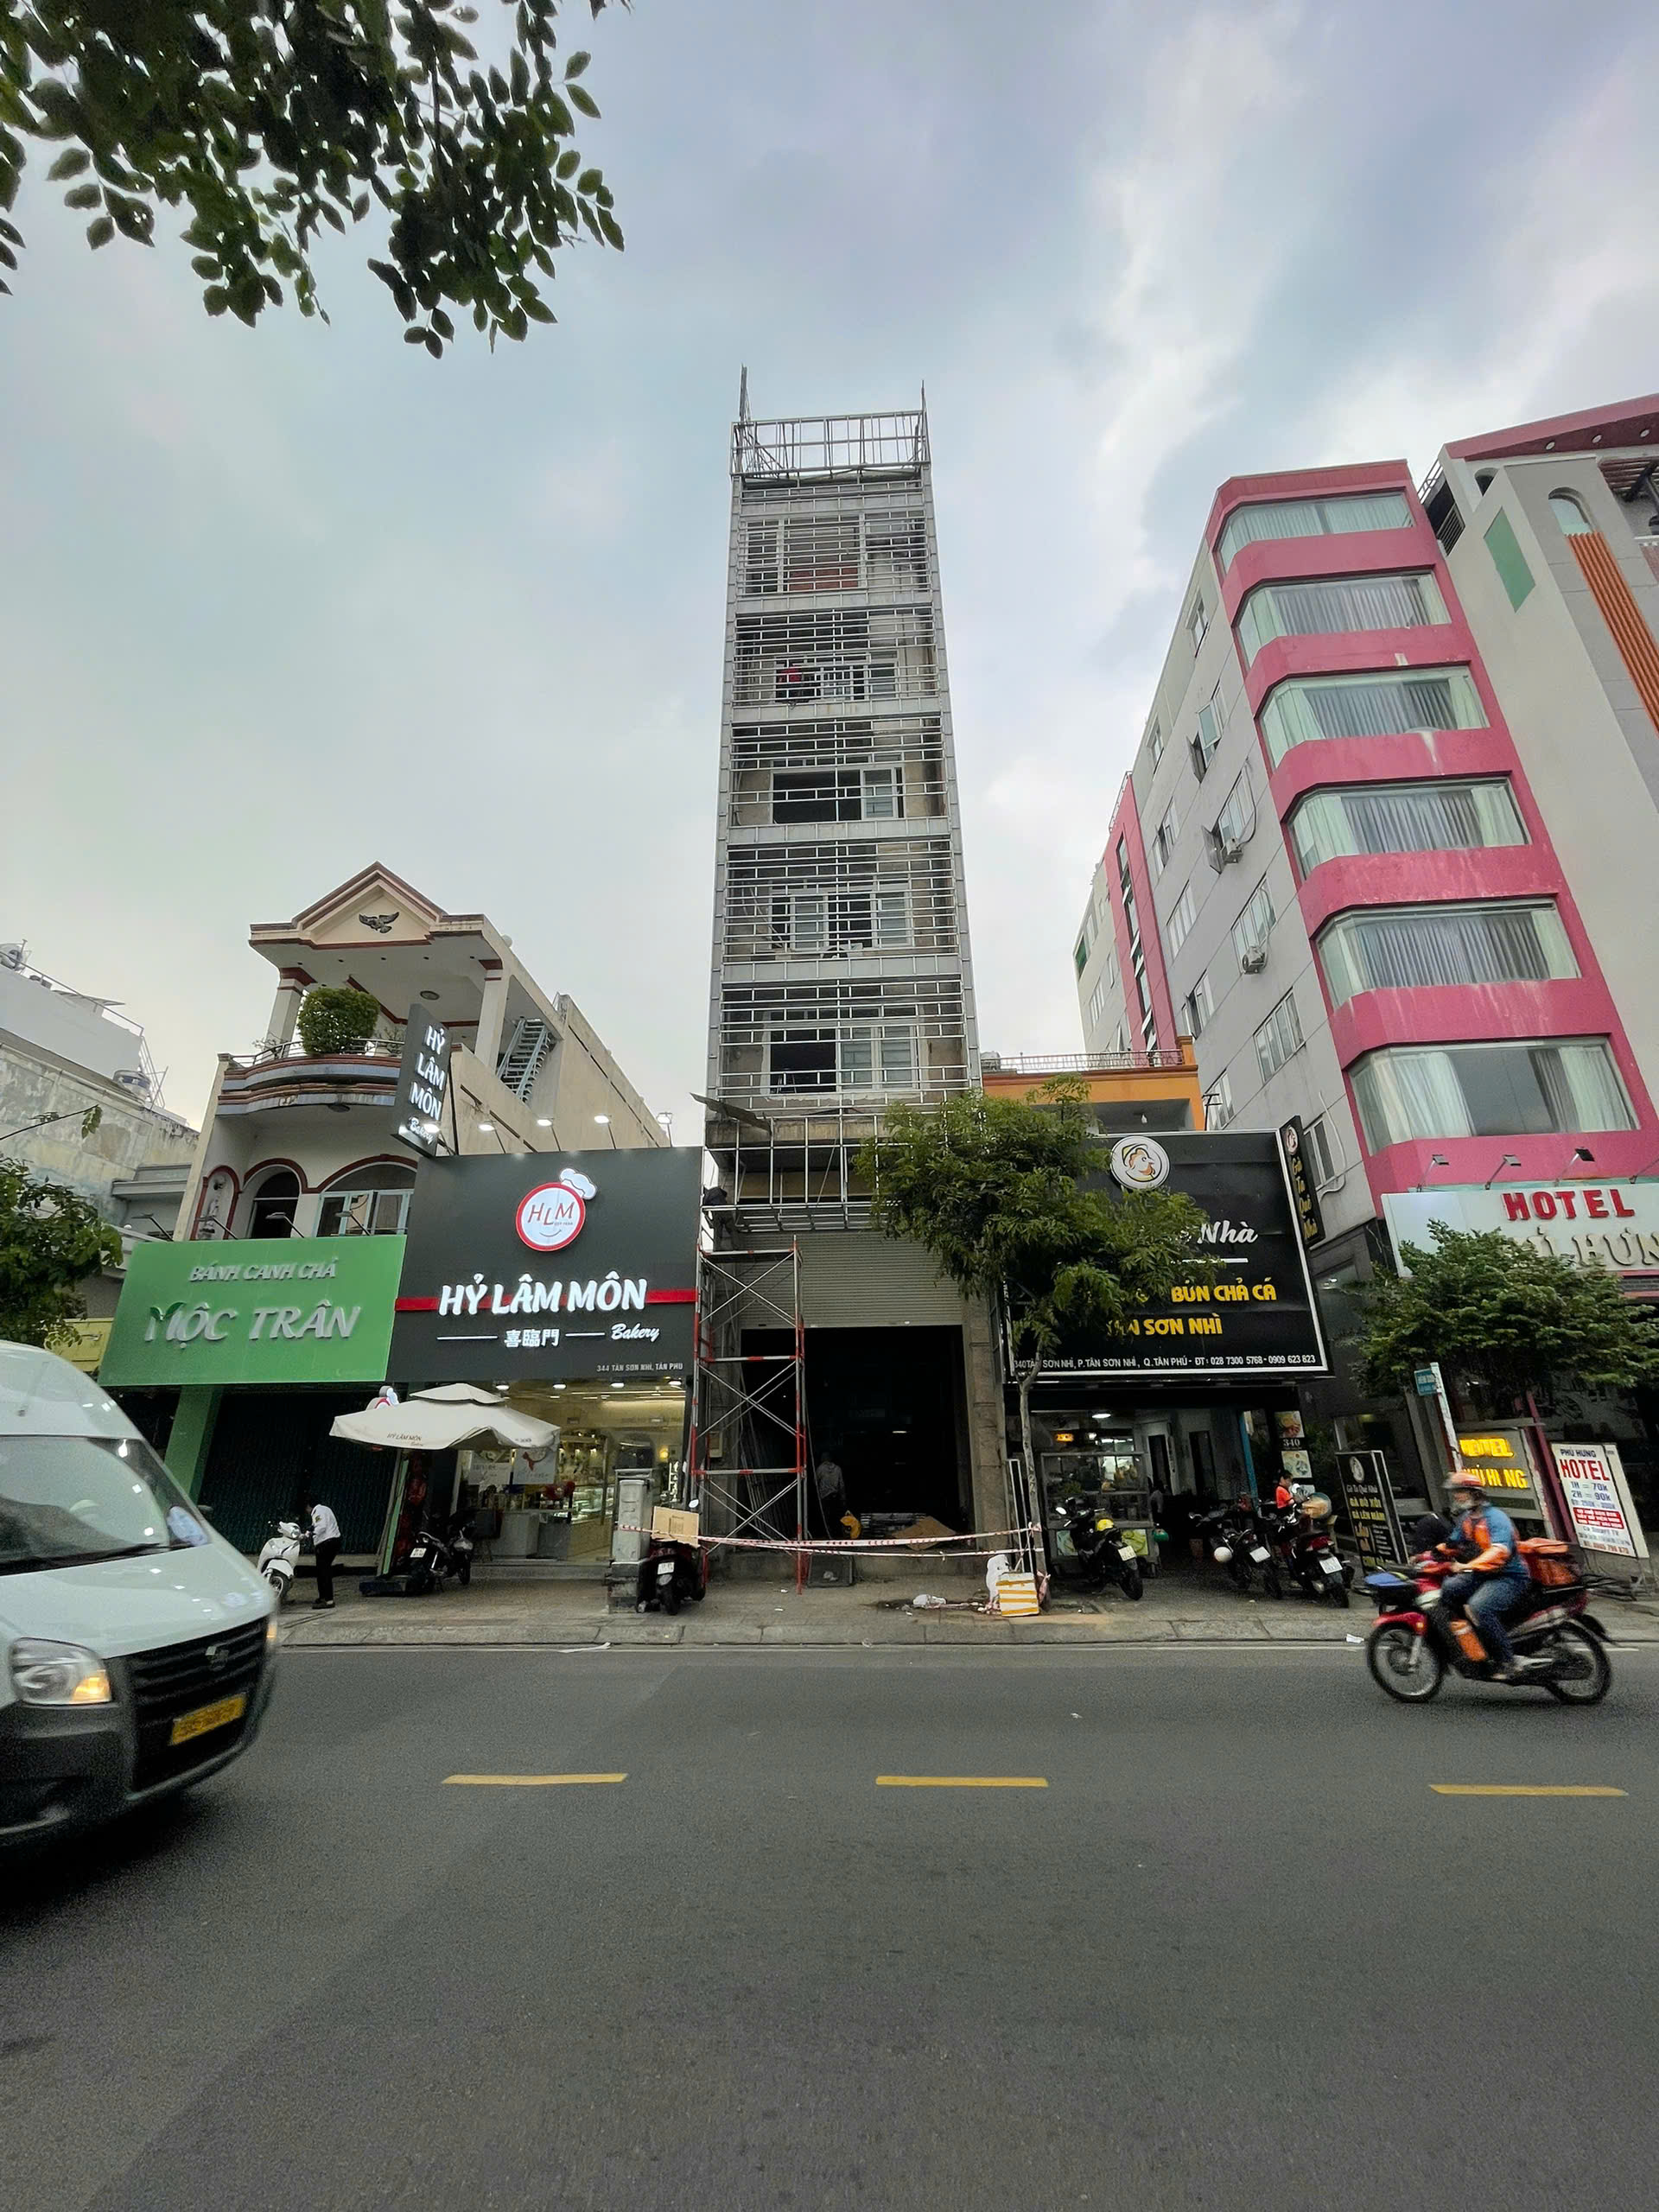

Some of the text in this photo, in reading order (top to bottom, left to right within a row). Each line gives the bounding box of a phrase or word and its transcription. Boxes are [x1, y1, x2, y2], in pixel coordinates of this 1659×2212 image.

[417, 1052, 446, 1090] LÂM
[410, 1082, 442, 1121] MÔN
[527, 1202, 575, 1225] HLM
[1502, 1188, 1636, 1221] HOTEL
[1197, 1219, 1258, 1243] Nhà
[189, 1261, 242, 1282] BÁNH
[243, 1262, 297, 1281] CANH
[438, 1270, 648, 1316] HỶ LÂM MÔN
[1171, 1279, 1211, 1302] BÚN
[1213, 1276, 1249, 1301] CHẢ
[1252, 1276, 1277, 1301] CÁ
[144, 1299, 361, 1349] MỘC TRÂN
[610, 1322, 660, 1343] Bakery
[1143, 1317, 1184, 1336] SƠN
[1188, 1313, 1223, 1335] NHÌ
[504, 1328, 560, 1348] 喜臨門
[1042, 1359, 1059, 1368] SƠN
[1103, 1357, 1121, 1367] SƠN
[1211, 1356, 1224, 1365] 028
[1225, 1356, 1243, 1365] 7300
[1287, 1355, 1300, 1363] 623
[1302, 1354, 1316, 1363] 823
[1282, 1438, 1300, 1447] 340
[1559, 1459, 1611, 1481] HOTEL
